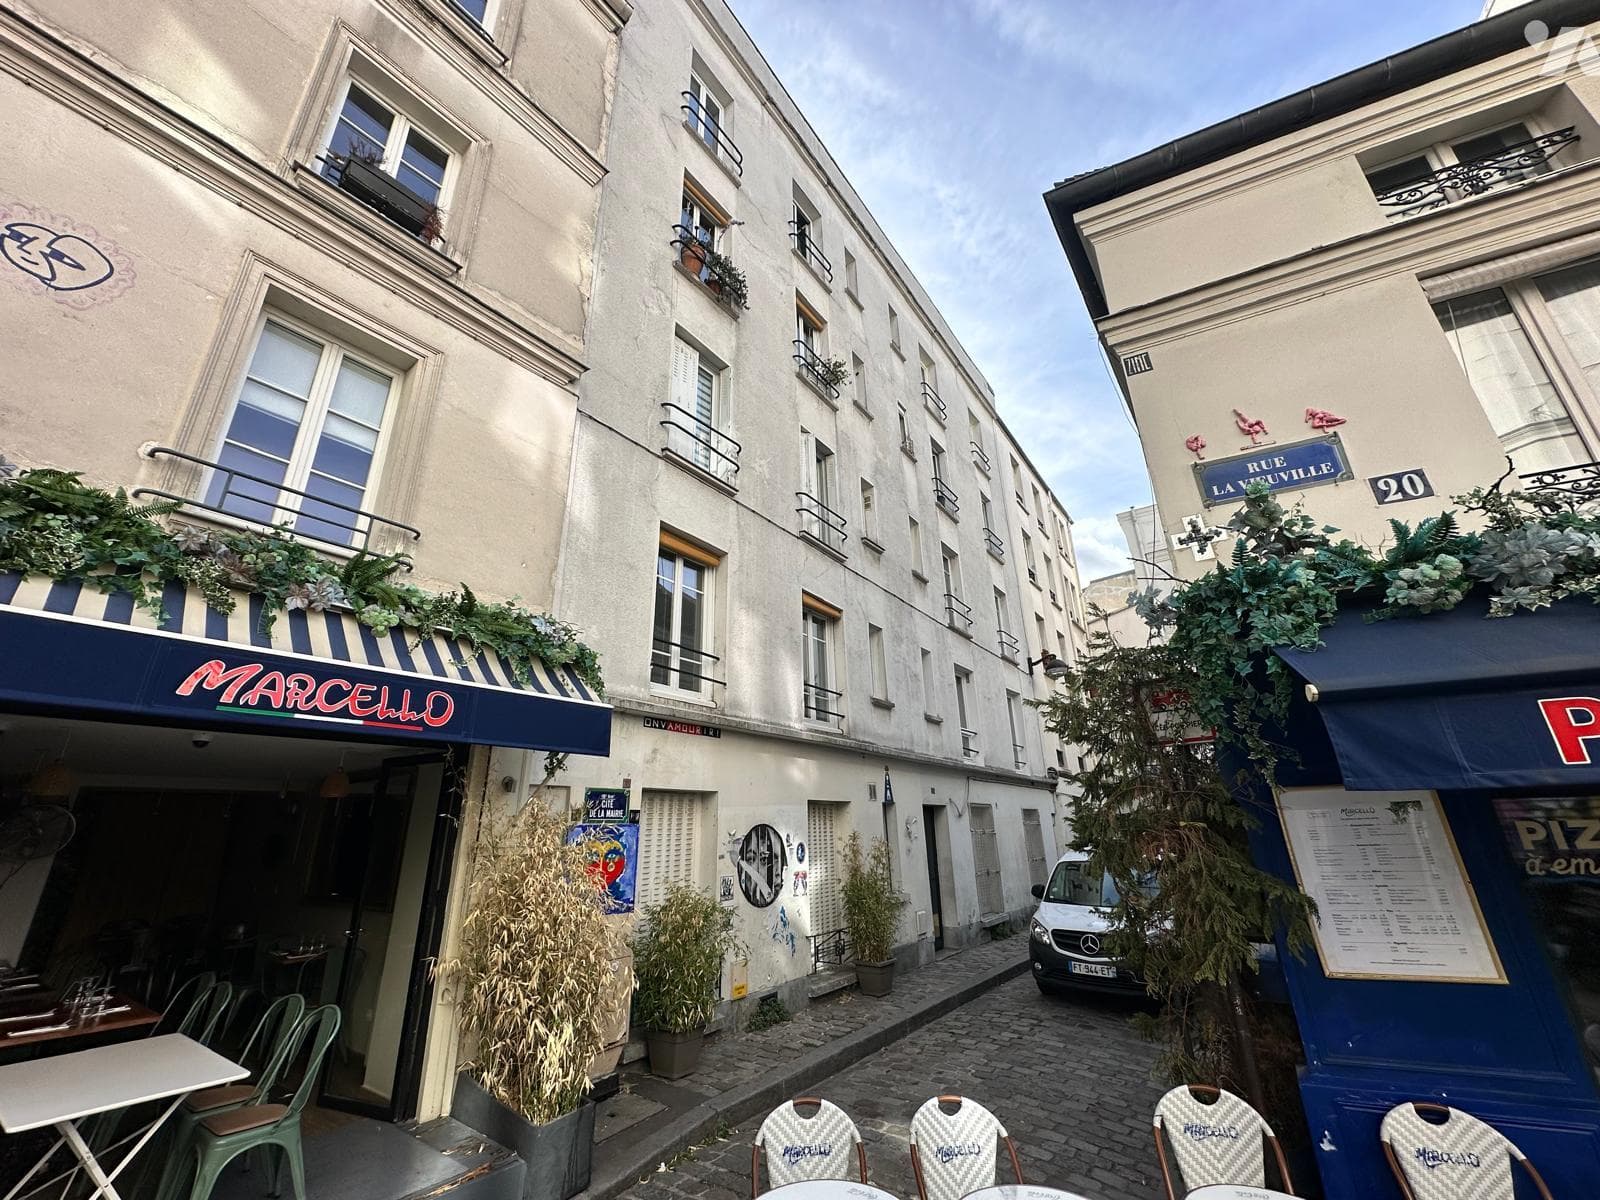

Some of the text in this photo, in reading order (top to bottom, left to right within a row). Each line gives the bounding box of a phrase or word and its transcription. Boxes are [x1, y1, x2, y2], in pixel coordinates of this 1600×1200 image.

[1247, 456, 1287, 473] RUE
[1213, 482, 1236, 496] LA
[1377, 473, 1426, 503] 20
[175, 659, 455, 727] MARCELLO
[606, 810, 624, 818] MAIRIE
